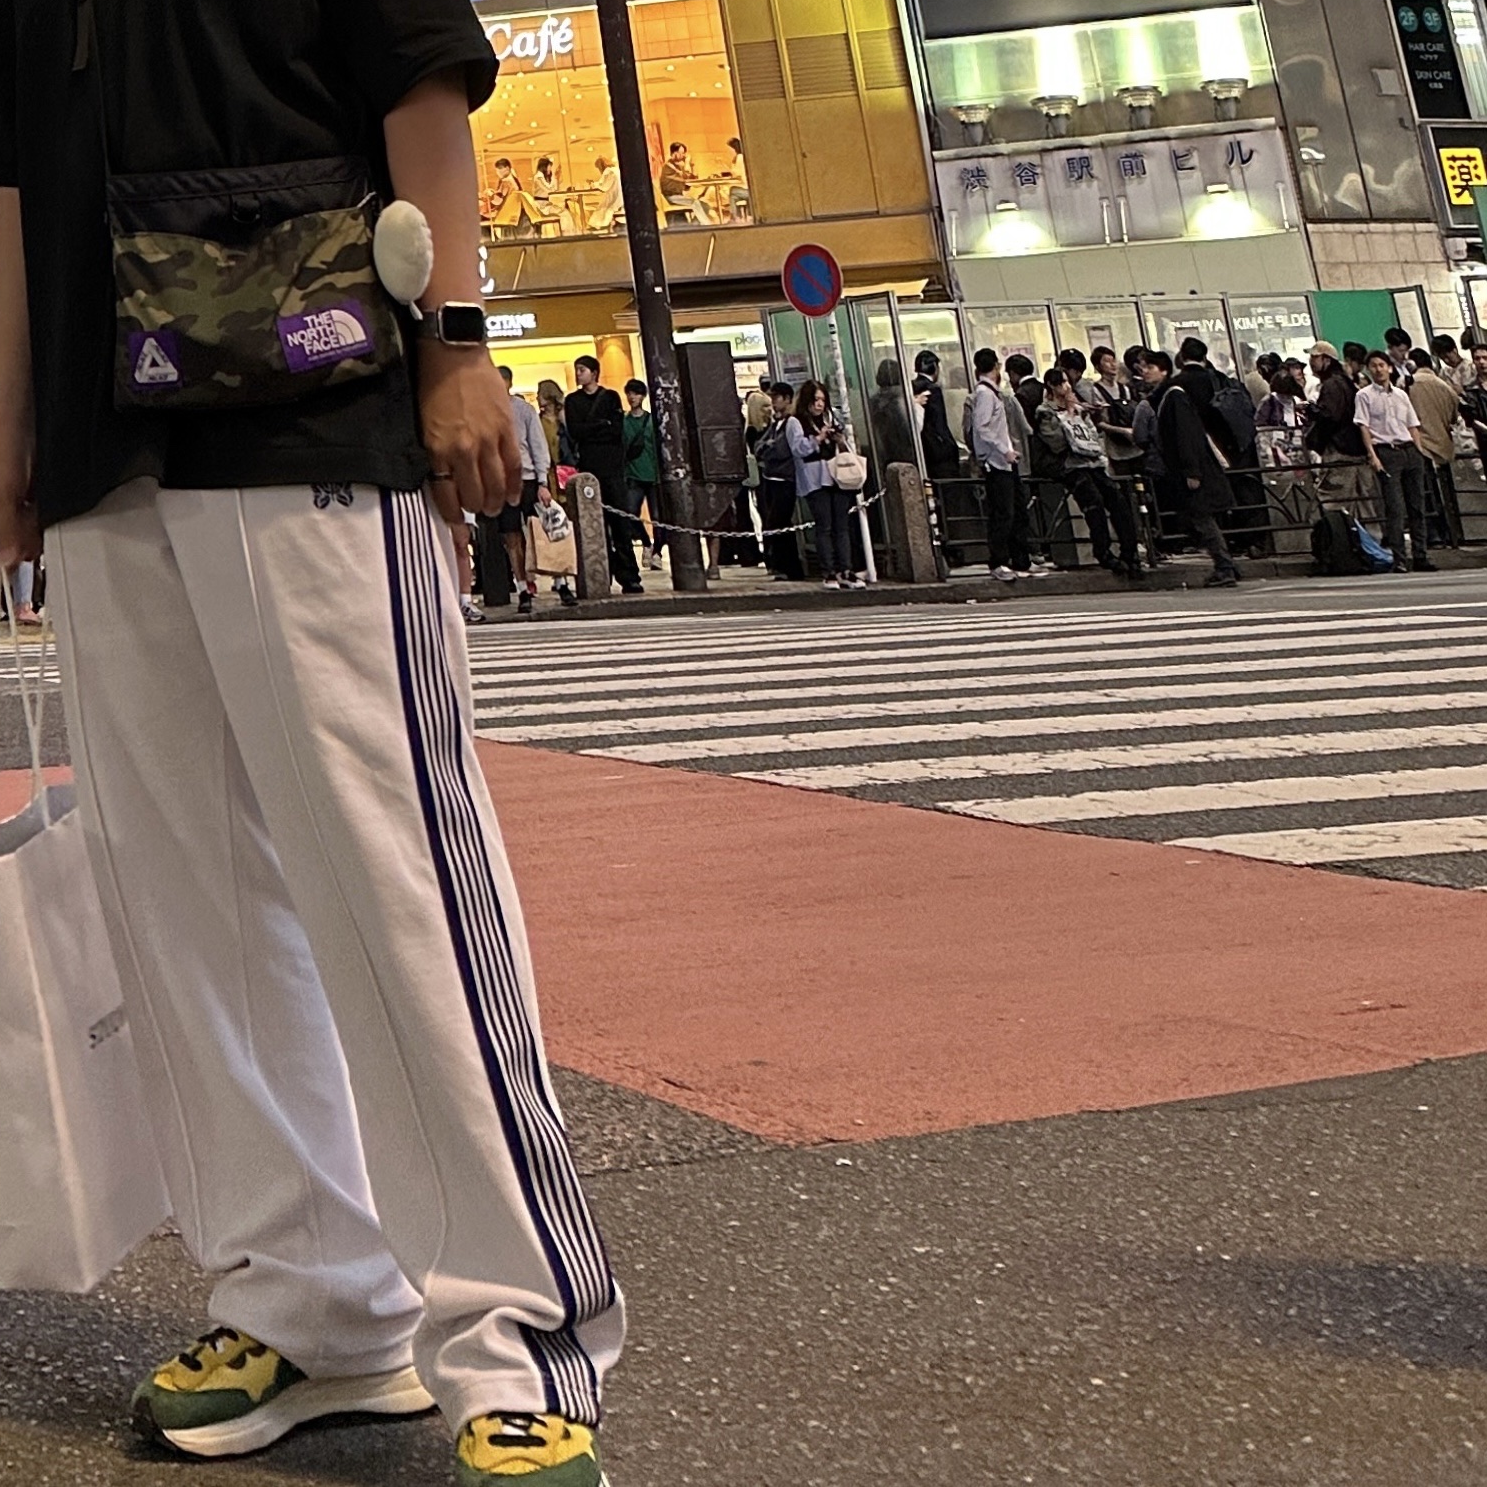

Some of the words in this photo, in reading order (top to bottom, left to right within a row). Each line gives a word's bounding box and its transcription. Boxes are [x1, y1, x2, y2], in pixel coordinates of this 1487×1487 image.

[482, 15, 574, 69] Café
[962, 140, 1254, 191] 渋谷駅前ビル
[303, 310, 333, 326] THE
[286, 324, 336, 348] NORTH
[304, 336, 341, 356] FACE
